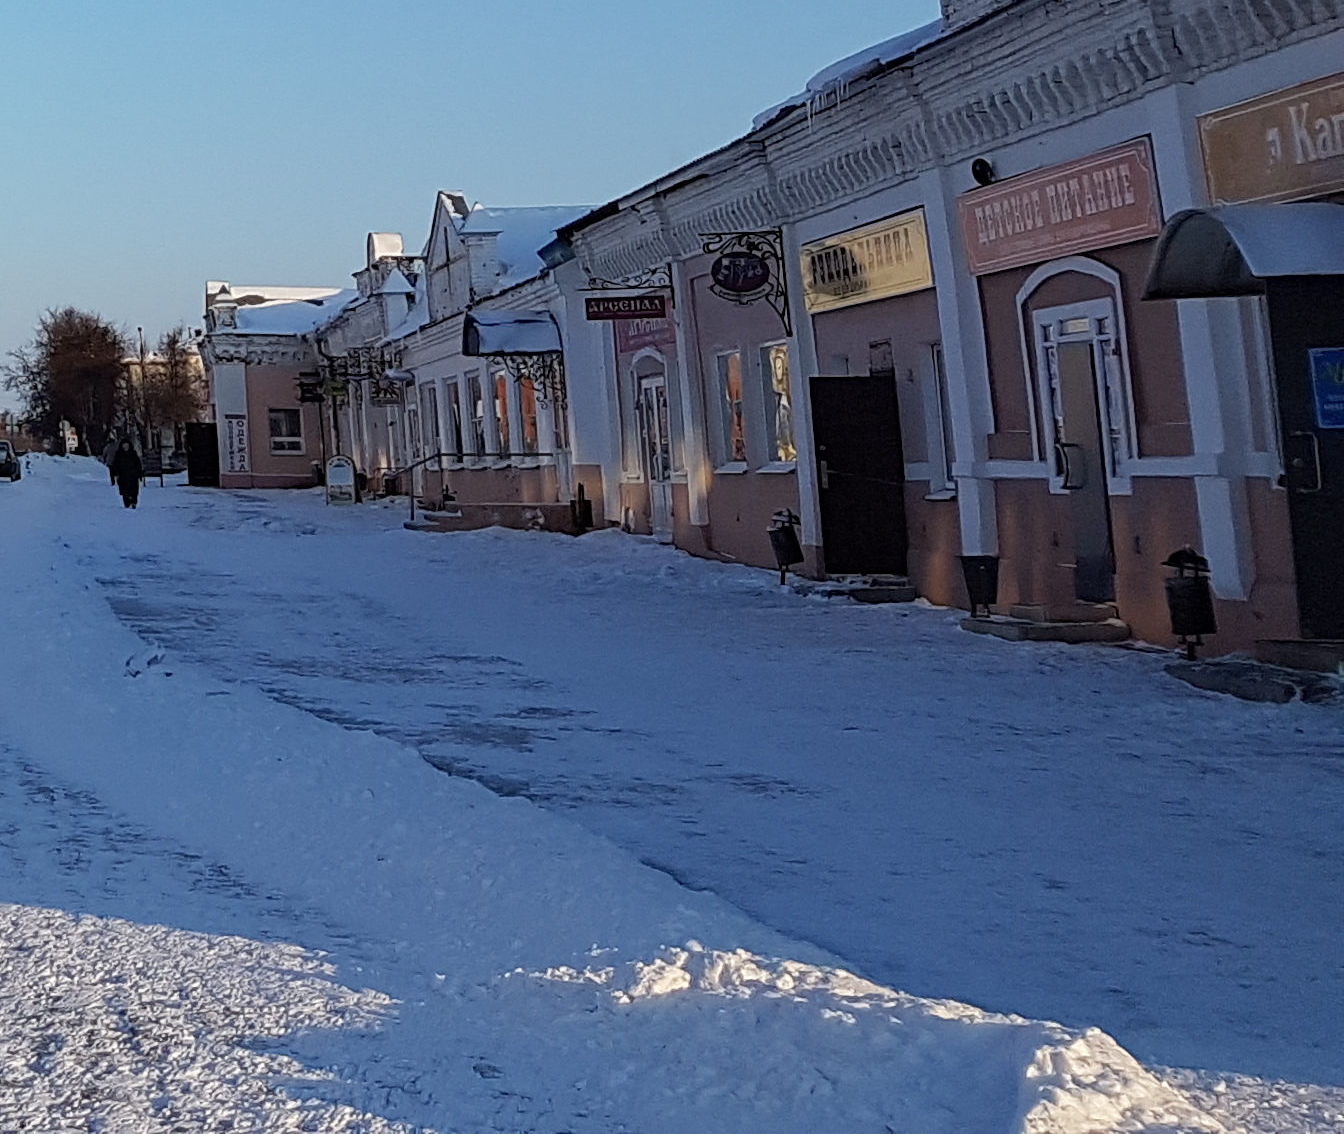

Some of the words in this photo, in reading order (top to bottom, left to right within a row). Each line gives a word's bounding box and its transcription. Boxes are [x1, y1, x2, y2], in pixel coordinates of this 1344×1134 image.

[974, 189, 1045, 245] ДЕТСКОЕ
[1045, 163, 1136, 225] ПИТАНИЕ
[588, 299, 662, 313] АРСЕНАЛ
[236, 420, 247, 471] ОДЕЖДА
